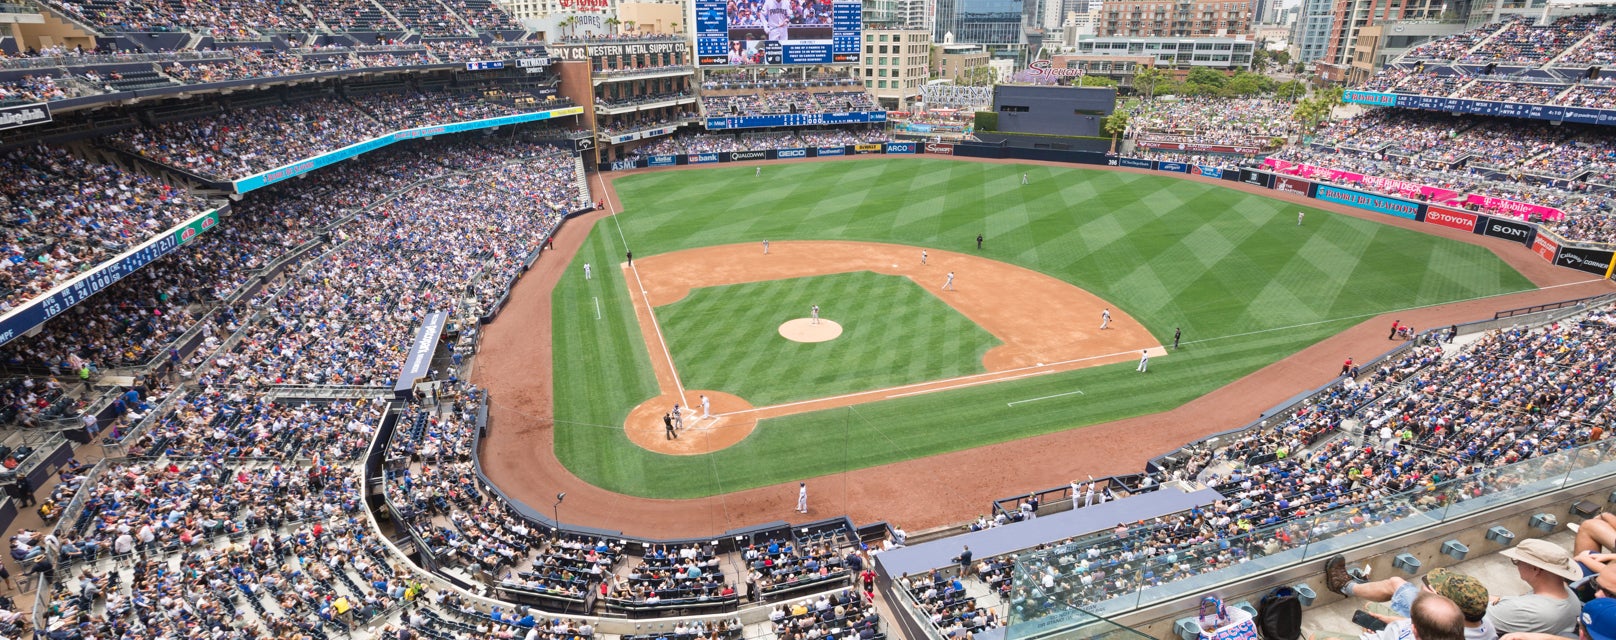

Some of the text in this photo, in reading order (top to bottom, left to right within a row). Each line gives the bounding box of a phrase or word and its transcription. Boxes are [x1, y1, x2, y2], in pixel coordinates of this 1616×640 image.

[575, 16, 600, 28] PADRES
[572, 48, 588, 60] CO.
[588, 43, 686, 56] WESTERN METAL SUPPLY CO.
[1029, 60, 1084, 80] Sycuan
[1352, 94, 1380, 102] BUMBLE
[928, 144, 950, 153] Sycuan
[731, 152, 764, 160] QUALCOMM
[612, 161, 636, 170] ASML
[1362, 176, 1422, 193] HOME RUN DECK
[1326, 190, 1417, 215] BUMBLE BEE SEAFOODS
[1440, 214, 1473, 227] TOYOTA
[1492, 224, 1528, 238] SONY
[160, 235, 176, 251] 2:17
[153, 249, 158, 257] 2
[111, 263, 120, 273] CHC
[1583, 260, 1609, 269] CORNER
[92, 275, 110, 291] 0 0 0
[42, 281, 85, 309] AVG HR RBI
[43, 289, 88, 320] .163 13 24
